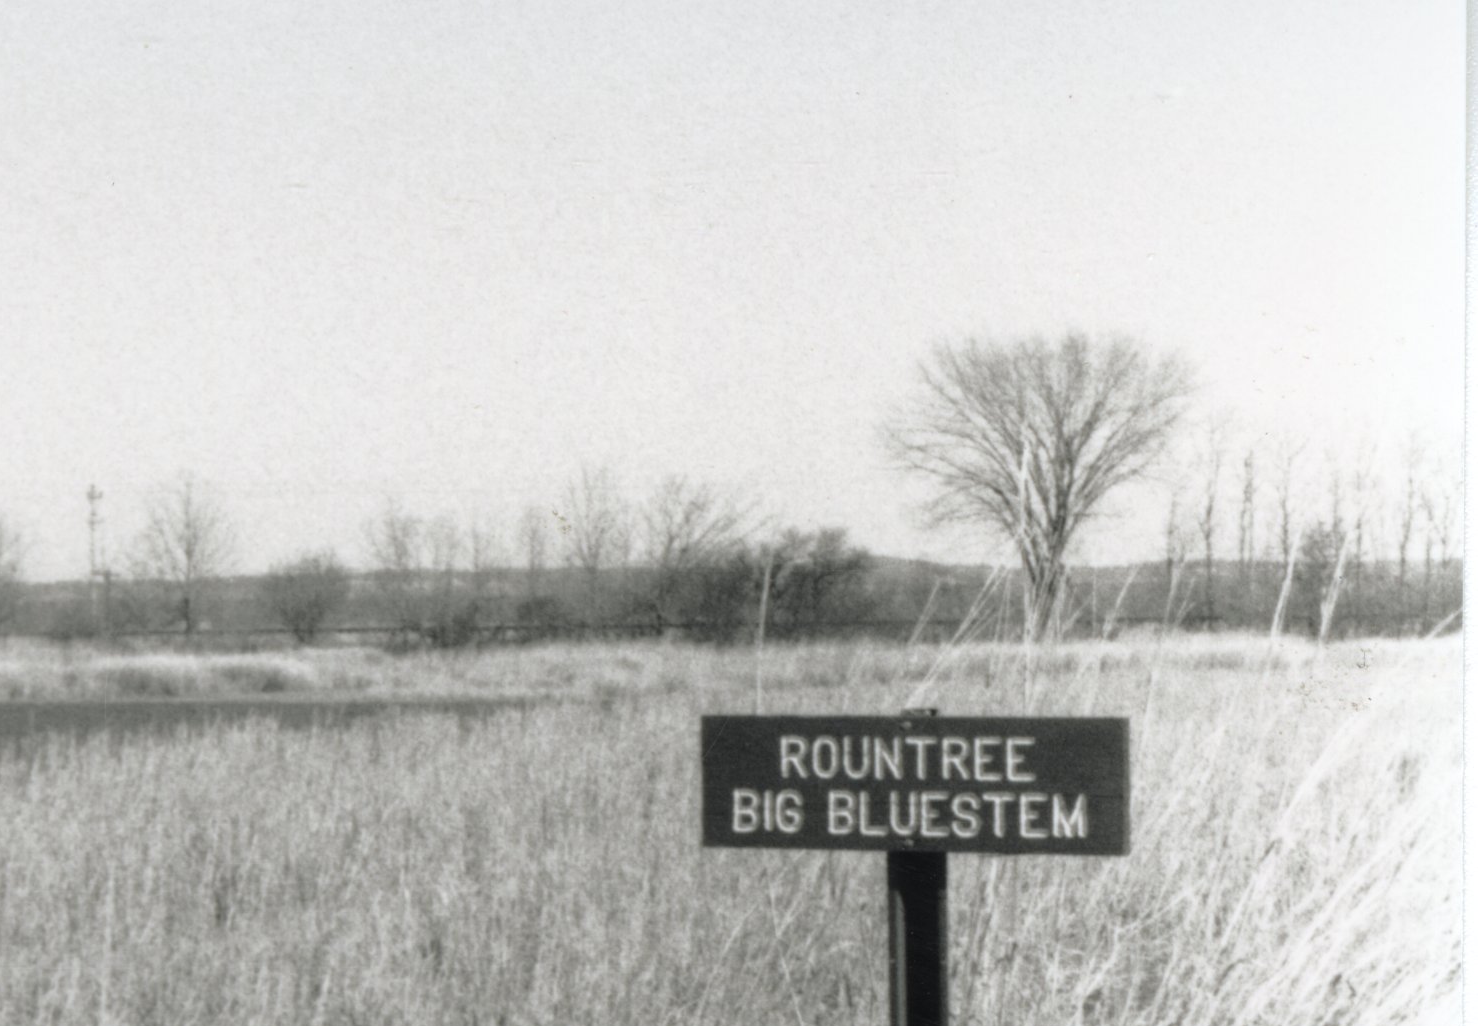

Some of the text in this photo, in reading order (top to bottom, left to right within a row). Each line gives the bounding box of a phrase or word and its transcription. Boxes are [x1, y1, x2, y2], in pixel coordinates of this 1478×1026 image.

[779, 735, 1035, 782] ROUNTREE
[731, 788, 1088, 838] BIG BLUESTEM
